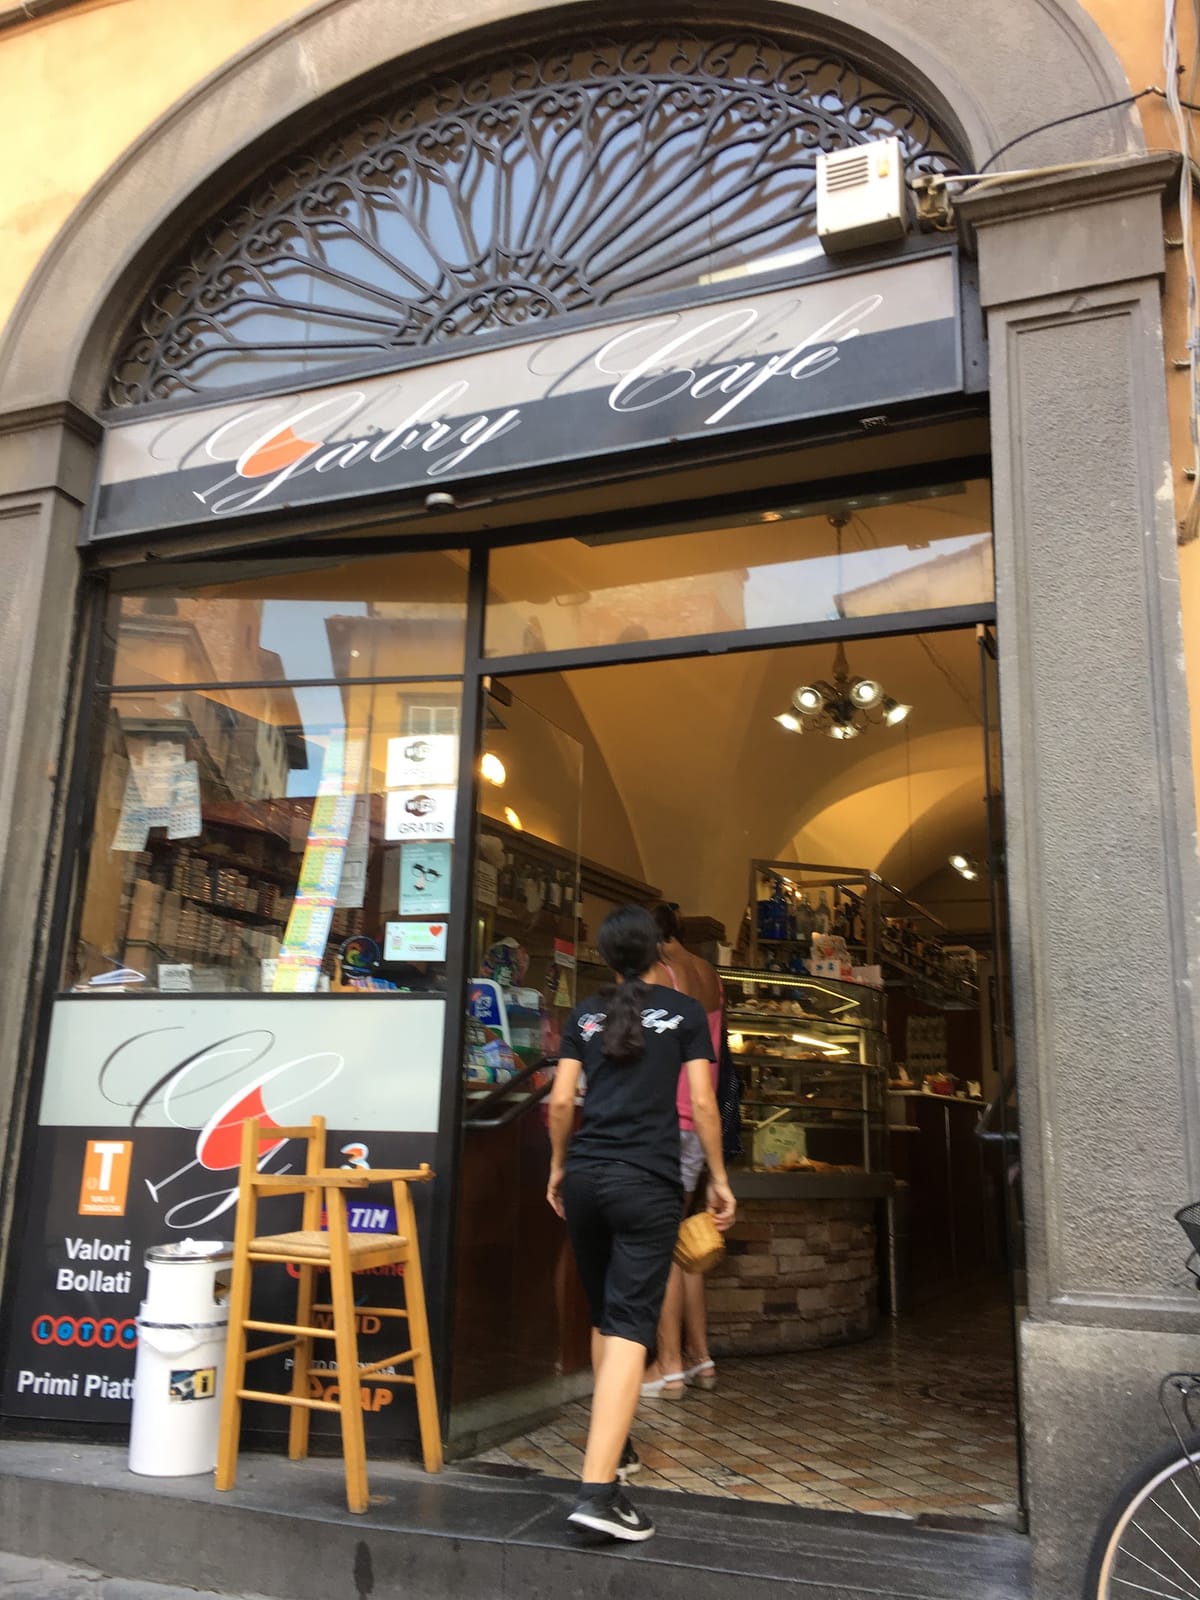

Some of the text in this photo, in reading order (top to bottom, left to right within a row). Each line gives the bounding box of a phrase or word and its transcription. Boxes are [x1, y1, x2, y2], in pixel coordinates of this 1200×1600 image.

[193, 295, 884, 514] Gabry Café
[398, 822, 445, 834] GRATIS
[94, 1142, 125, 1191] T
[351, 1208, 389, 1229] TIM
[65, 1237, 132, 1262] Valori
[56, 1268, 132, 1293] Bollati
[17, 1370, 79, 1396] Primi
